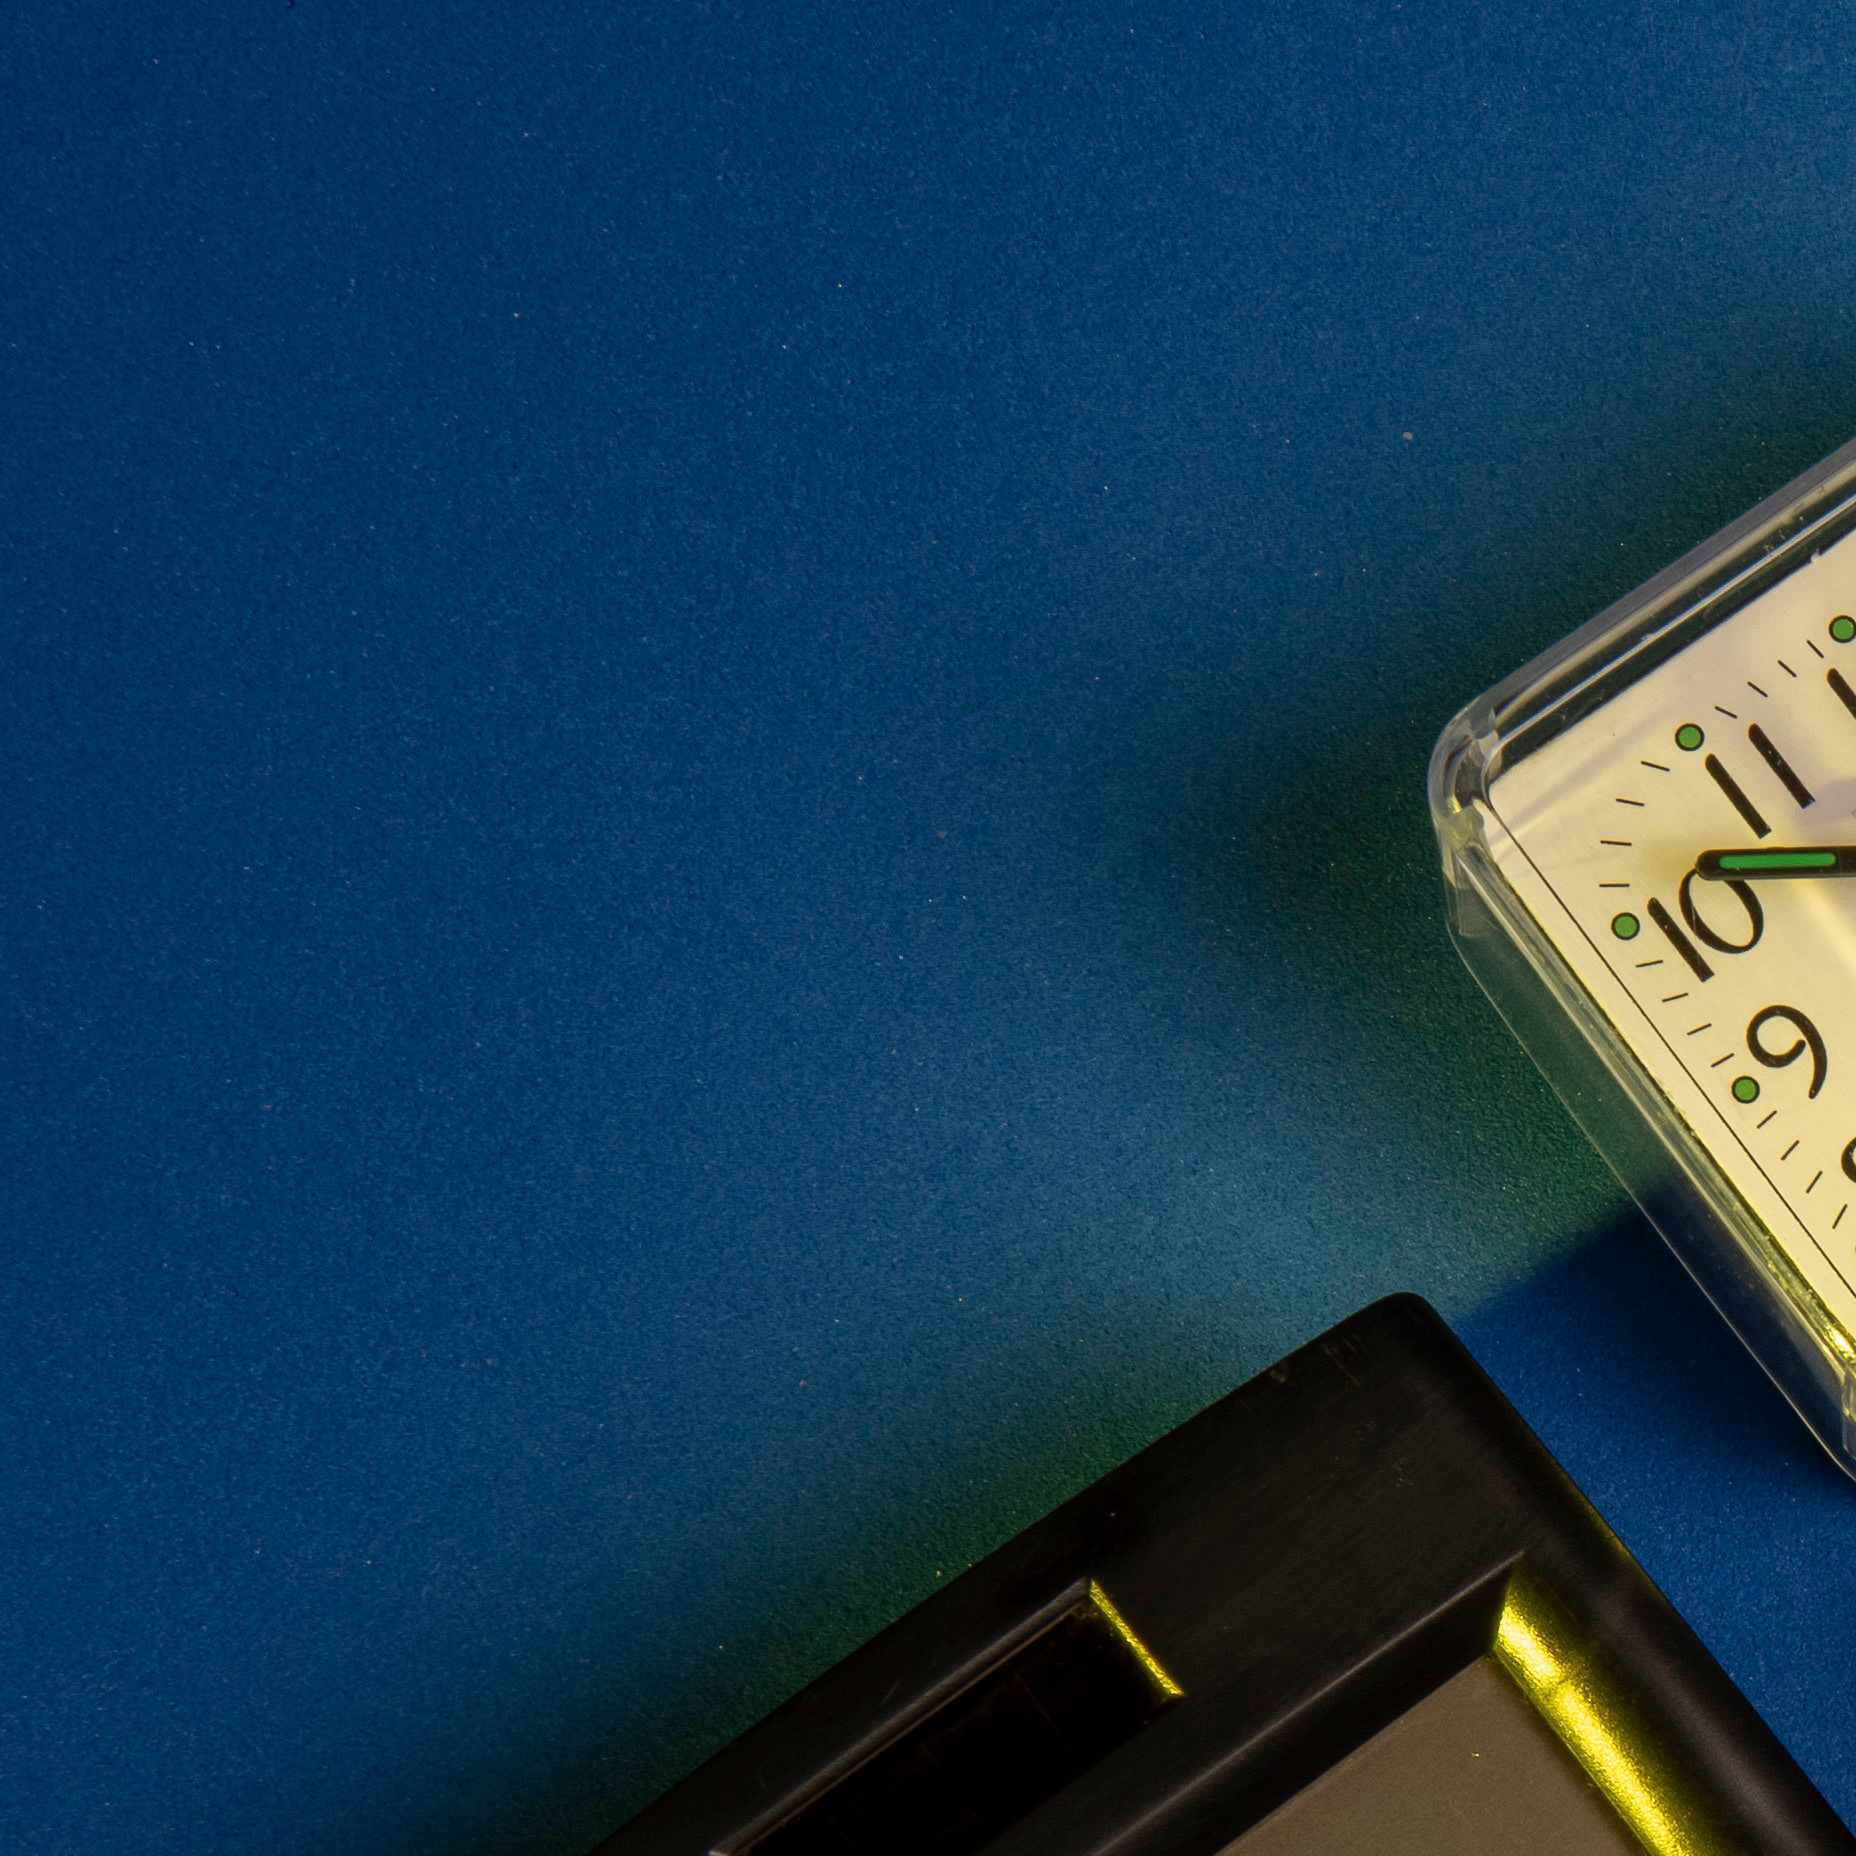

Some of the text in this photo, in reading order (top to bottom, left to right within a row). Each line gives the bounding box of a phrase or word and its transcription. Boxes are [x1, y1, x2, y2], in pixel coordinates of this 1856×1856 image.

[1705, 723, 1816, 840] 11
[1646, 865, 1765, 984] 10
[1746, 1005, 1828, 1100] 9
